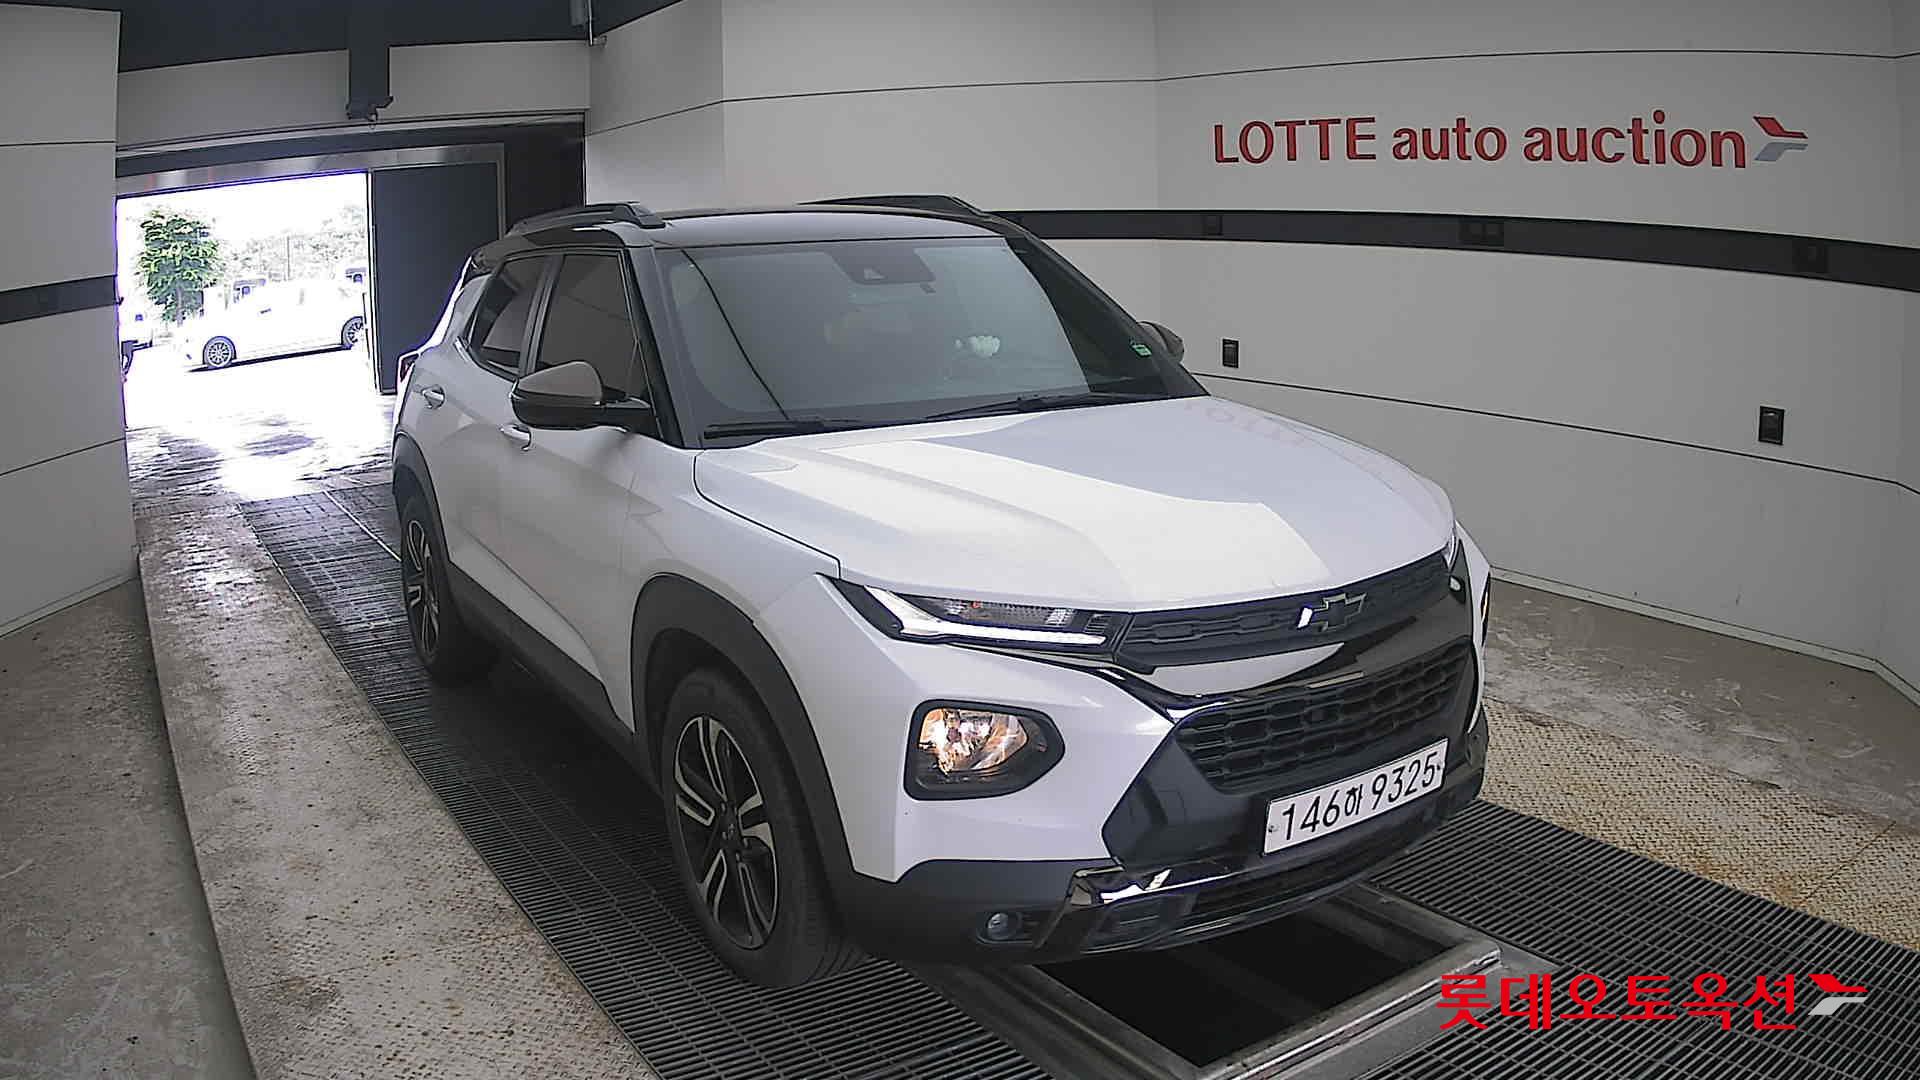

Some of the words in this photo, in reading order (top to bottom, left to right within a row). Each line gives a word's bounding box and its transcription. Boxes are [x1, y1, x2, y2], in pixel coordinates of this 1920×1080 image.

[1213, 117, 1376, 164] LOTTE
[1392, 116, 1508, 162] auto
[1522, 110, 1747, 169] auction
[1281, 783, 1364, 841] 146하
[1371, 751, 1439, 811] 9325
